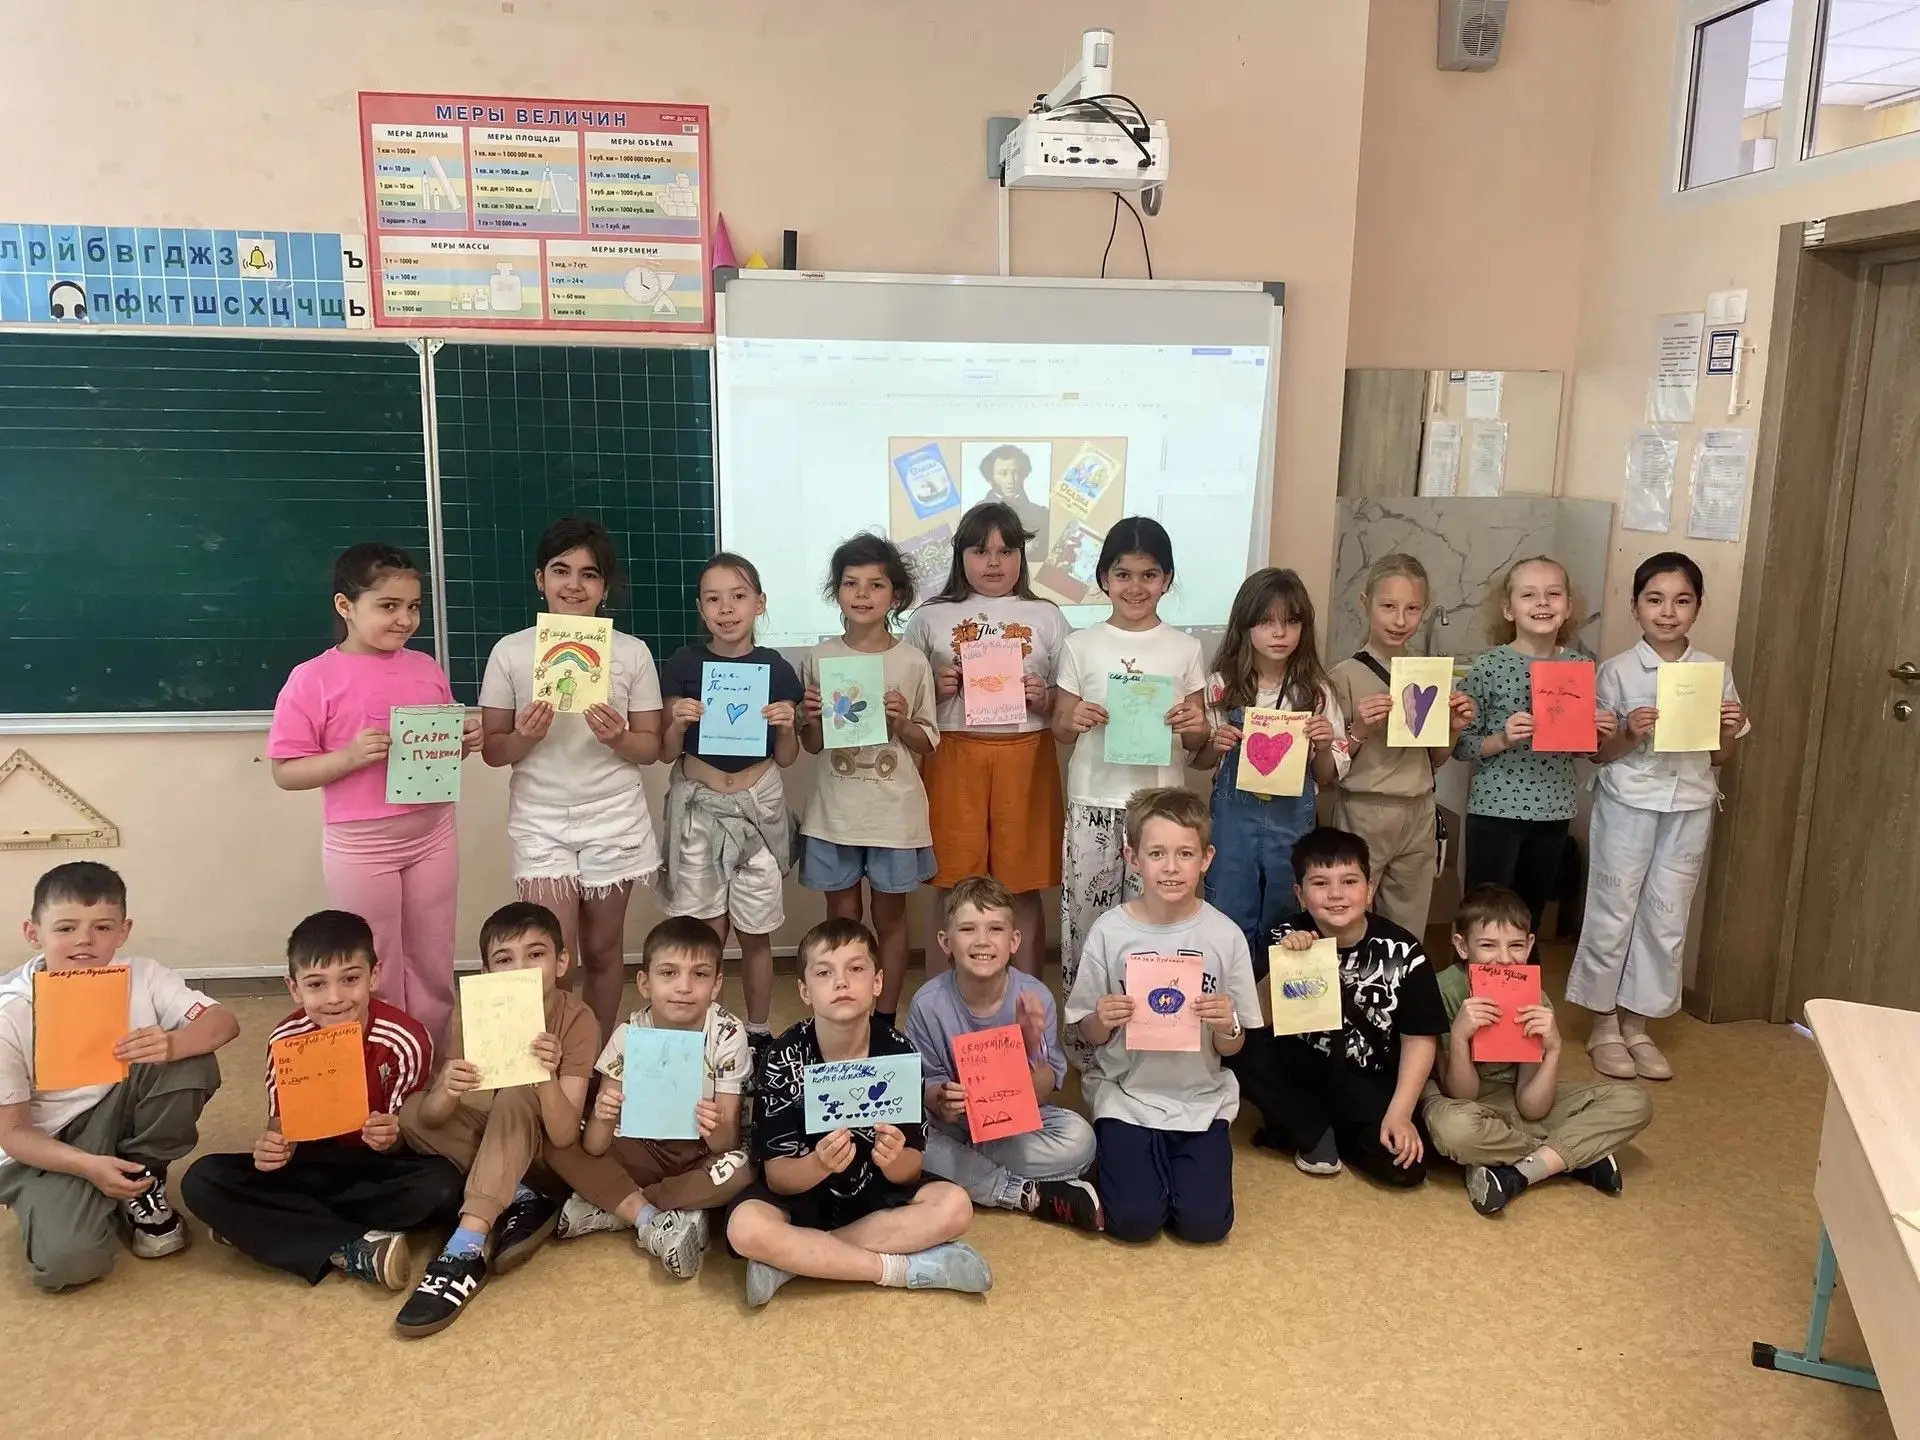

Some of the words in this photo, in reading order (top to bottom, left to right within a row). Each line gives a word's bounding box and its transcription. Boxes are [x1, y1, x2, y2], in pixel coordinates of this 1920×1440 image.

[436, 105, 505, 123] МЕРЫ
[516, 109, 627, 127] ВЕЛИЧИН
[515, 134, 561, 143] ПЛОЩАДИ
[638, 139, 673, 147] ОБЪЁМА
[619, 246, 658, 254] ВРЕМЕНИ
[976, 623, 998, 640] The
[1088, 810, 1112, 831] ART
[1092, 890, 1116, 908] ART
